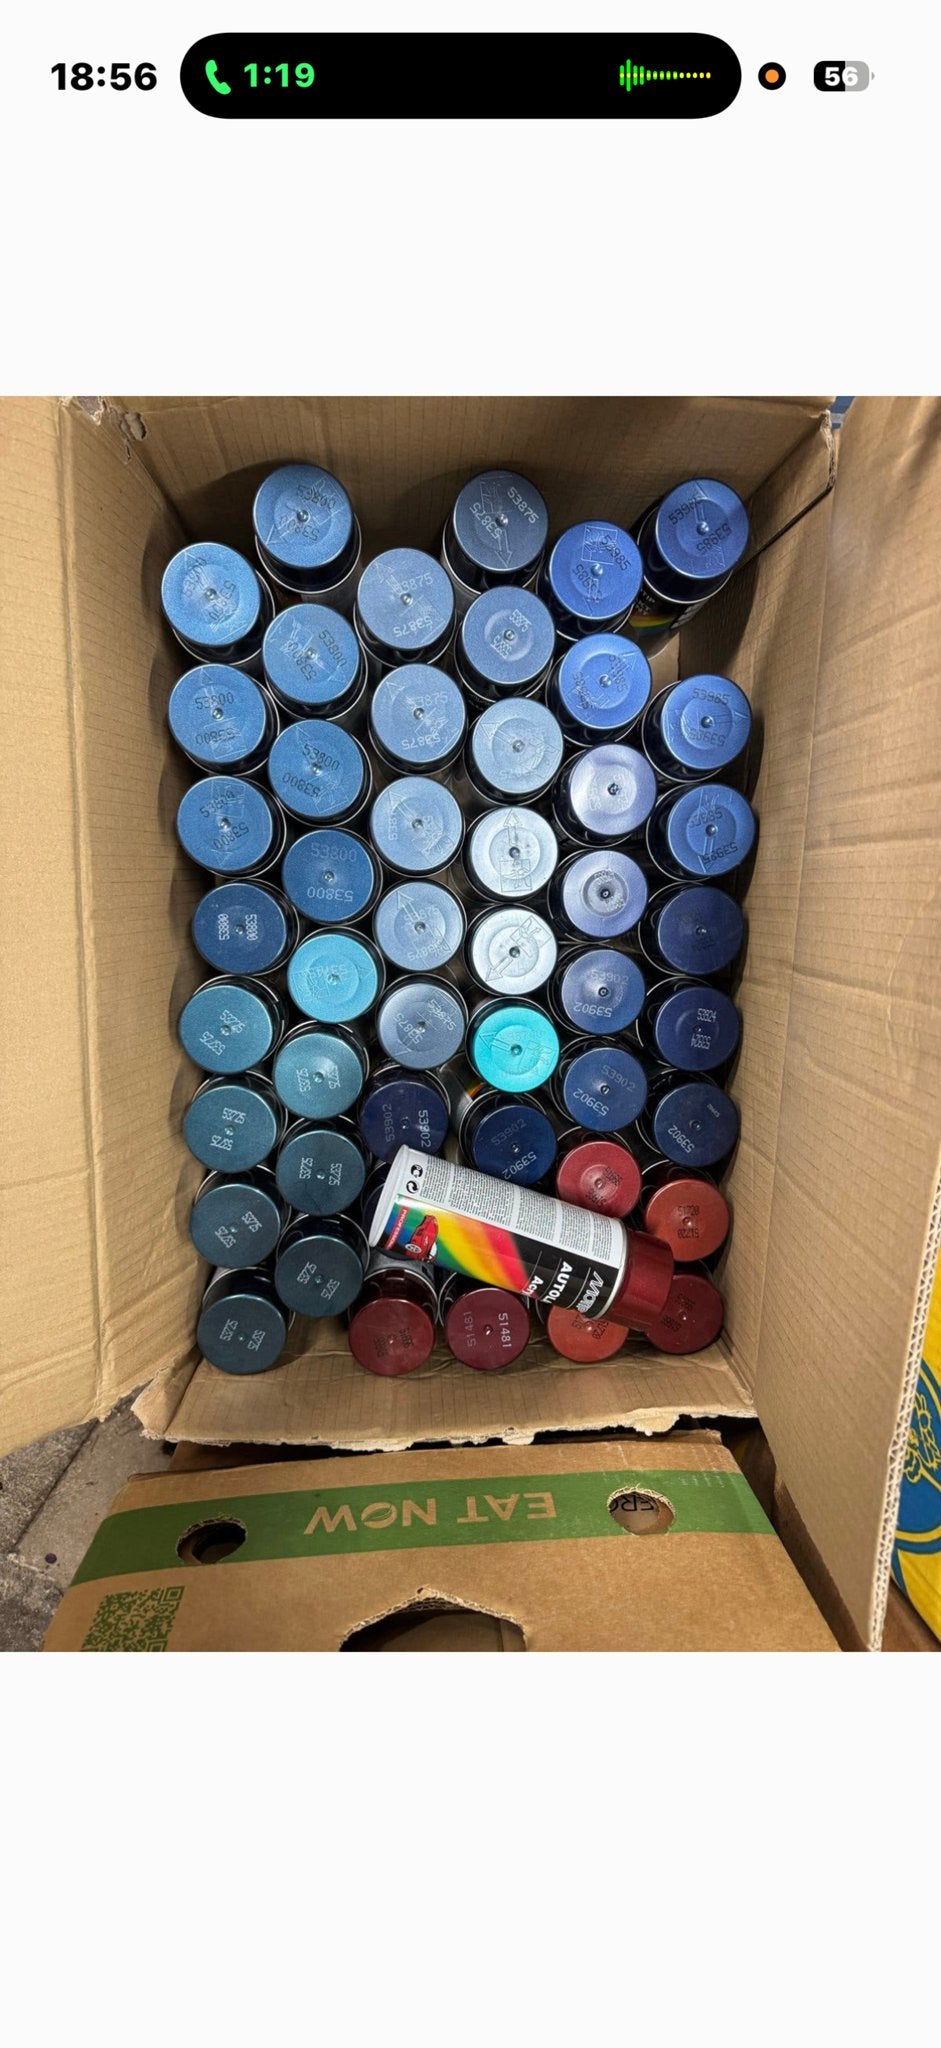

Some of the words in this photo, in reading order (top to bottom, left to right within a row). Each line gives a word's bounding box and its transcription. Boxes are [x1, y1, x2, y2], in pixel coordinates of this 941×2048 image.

[507, 487, 539, 524] 53875
[469, 502, 503, 540] 53875
[696, 522, 732, 555] 53985
[393, 616, 433, 638] 53875
[318, 629, 348, 668] 53800
[194, 691, 235, 711] 53800
[195, 727, 236, 746] 53800
[401, 732, 442, 750] 53875
[302, 743, 341, 772] 53800
[282, 772, 321, 798] 53800
[212, 822, 249, 850] 53800
[311, 842, 358, 861] 53800
[307, 886, 354, 902] 53800
[218, 913, 230, 941] 53800
[245, 913, 258, 941] 53800
[590, 968, 629, 986] 53902
[573, 1001, 613, 1018] 53902
[393, 1013, 424, 1044] 53875
[200, 1031, 226, 1056] 53725
[601, 1064, 636, 1093] 53902
[572, 1087, 610, 1117] 53902
[381, 1103, 396, 1144] 53902
[418, 1109, 432, 1149] 53902
[490, 1118, 528, 1146] 53902
[667, 1124, 696, 1154] 53902
[501, 1151, 538, 1180] 53902
[463, 1310, 477, 1347] 51481
[498, 1312, 513, 1348] 51481
[303, 1498, 437, 1535] NOW
[456, 1491, 557, 1523] EAT
